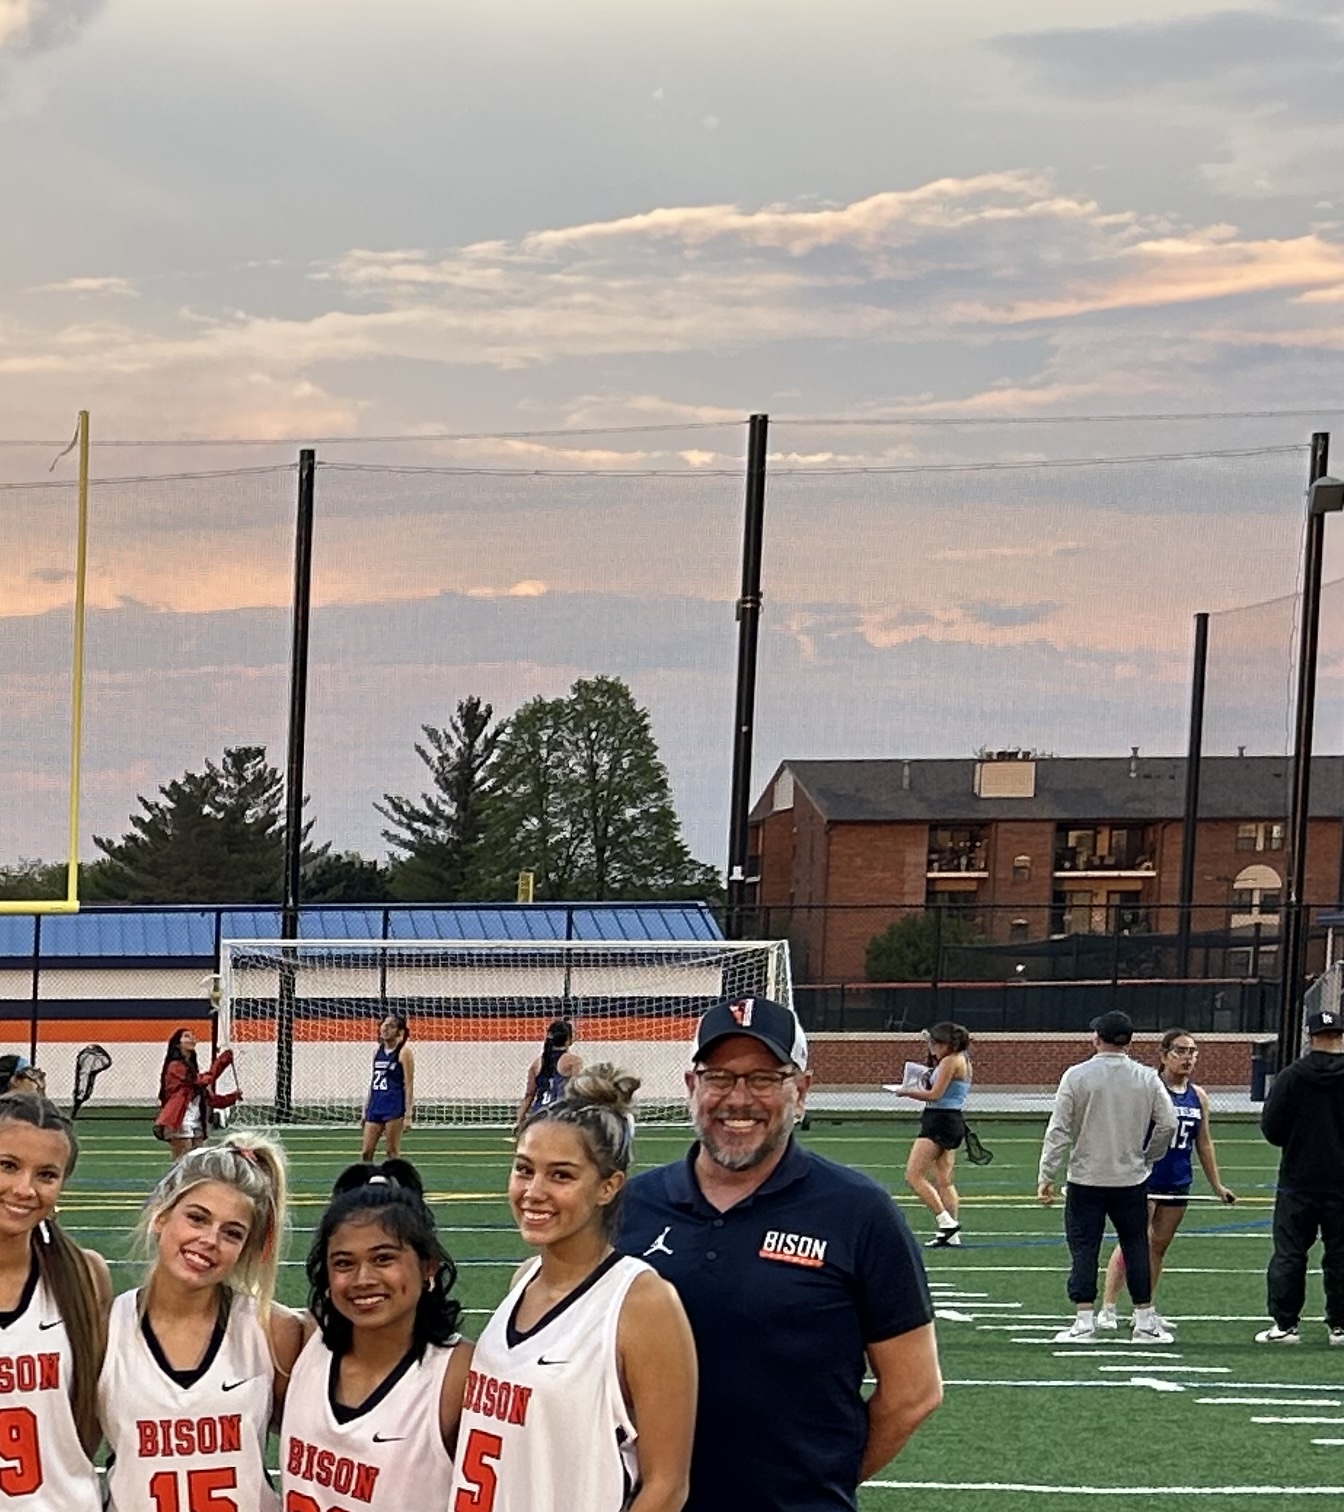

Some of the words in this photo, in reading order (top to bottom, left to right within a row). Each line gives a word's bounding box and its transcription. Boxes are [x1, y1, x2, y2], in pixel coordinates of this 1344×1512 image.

[763, 1231, 828, 1260] BISON
[463, 1370, 532, 1426] BISON
[136, 1413, 242, 1457] BISON
[287, 1437, 379, 1503] BISON
